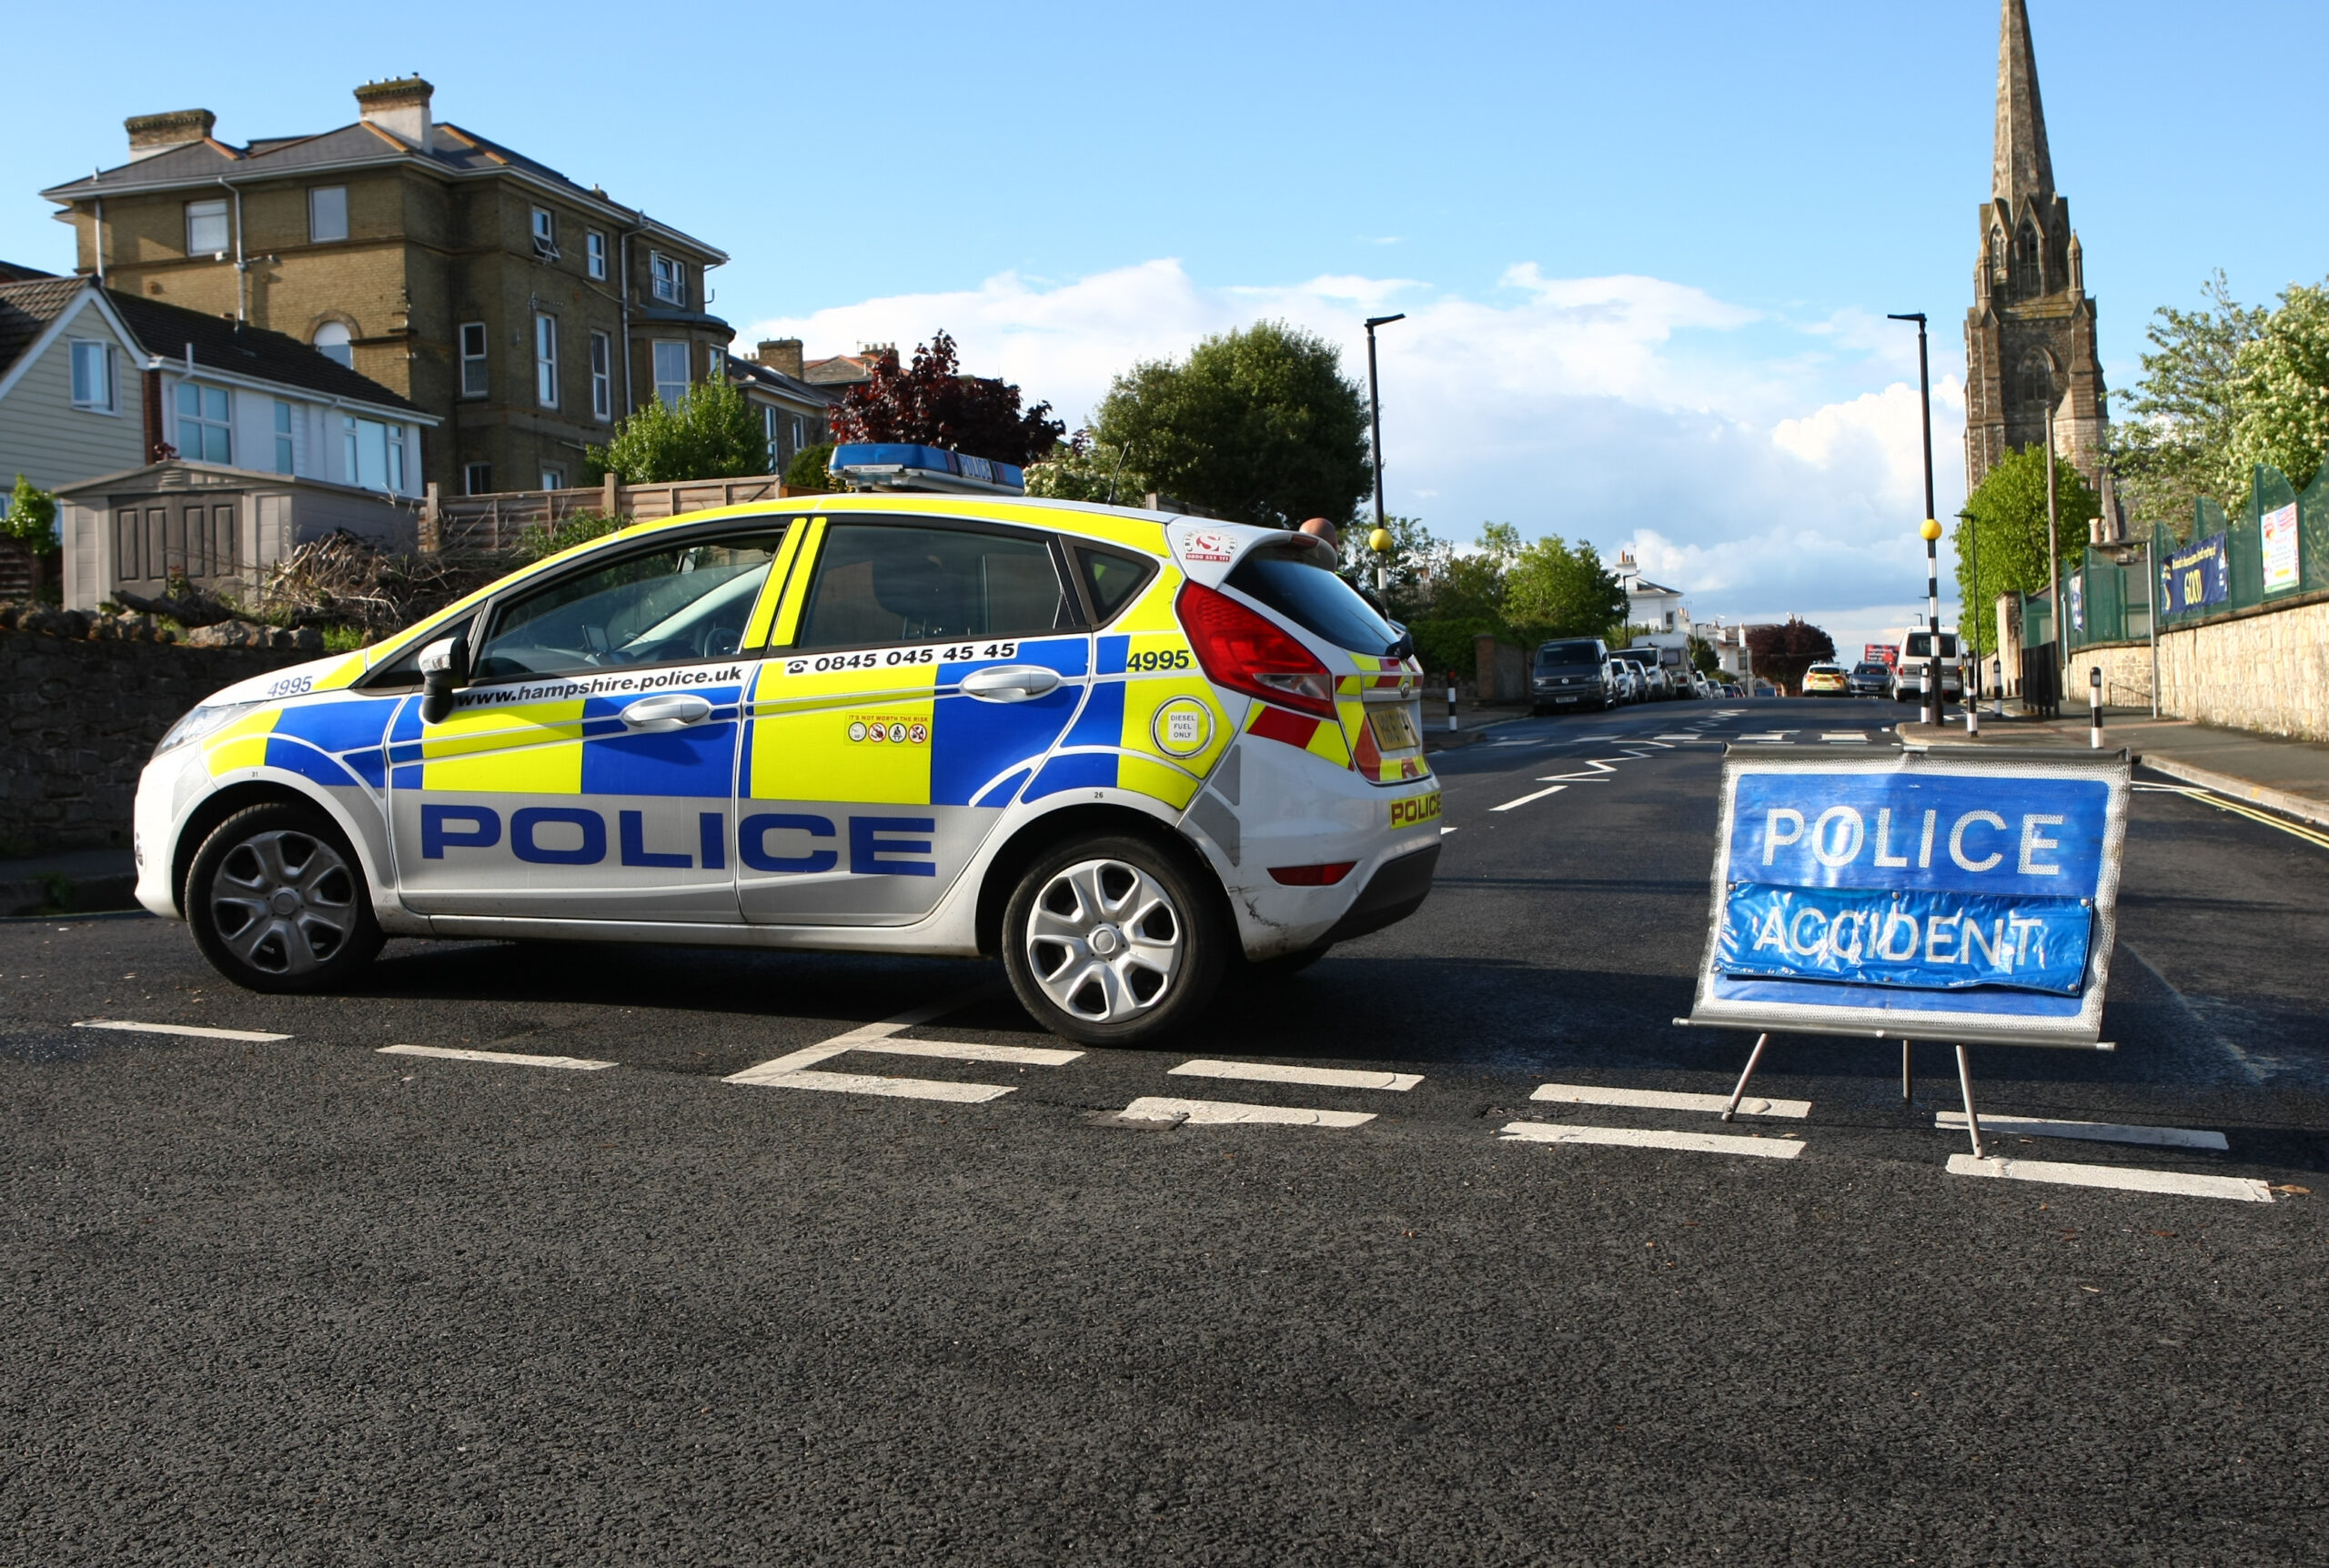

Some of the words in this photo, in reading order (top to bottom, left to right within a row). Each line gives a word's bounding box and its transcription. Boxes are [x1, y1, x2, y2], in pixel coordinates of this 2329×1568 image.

[959, 454, 992, 481] POLICE
[814, 654, 877, 671] 0845
[886, 648, 933, 667] 045
[943, 645, 973, 660] 45
[983, 643, 1015, 658] 45
[1126, 649, 1189, 671] 4995
[267, 675, 313, 697] 4995
[457, 666, 743, 707] www.hampshire.police.uk
[1391, 793, 1442, 825] POLICE
[420, 803, 936, 877] POLICE
[1761, 805, 2063, 875] POLICE
[1752, 905, 2043, 967] ACCIDENT
